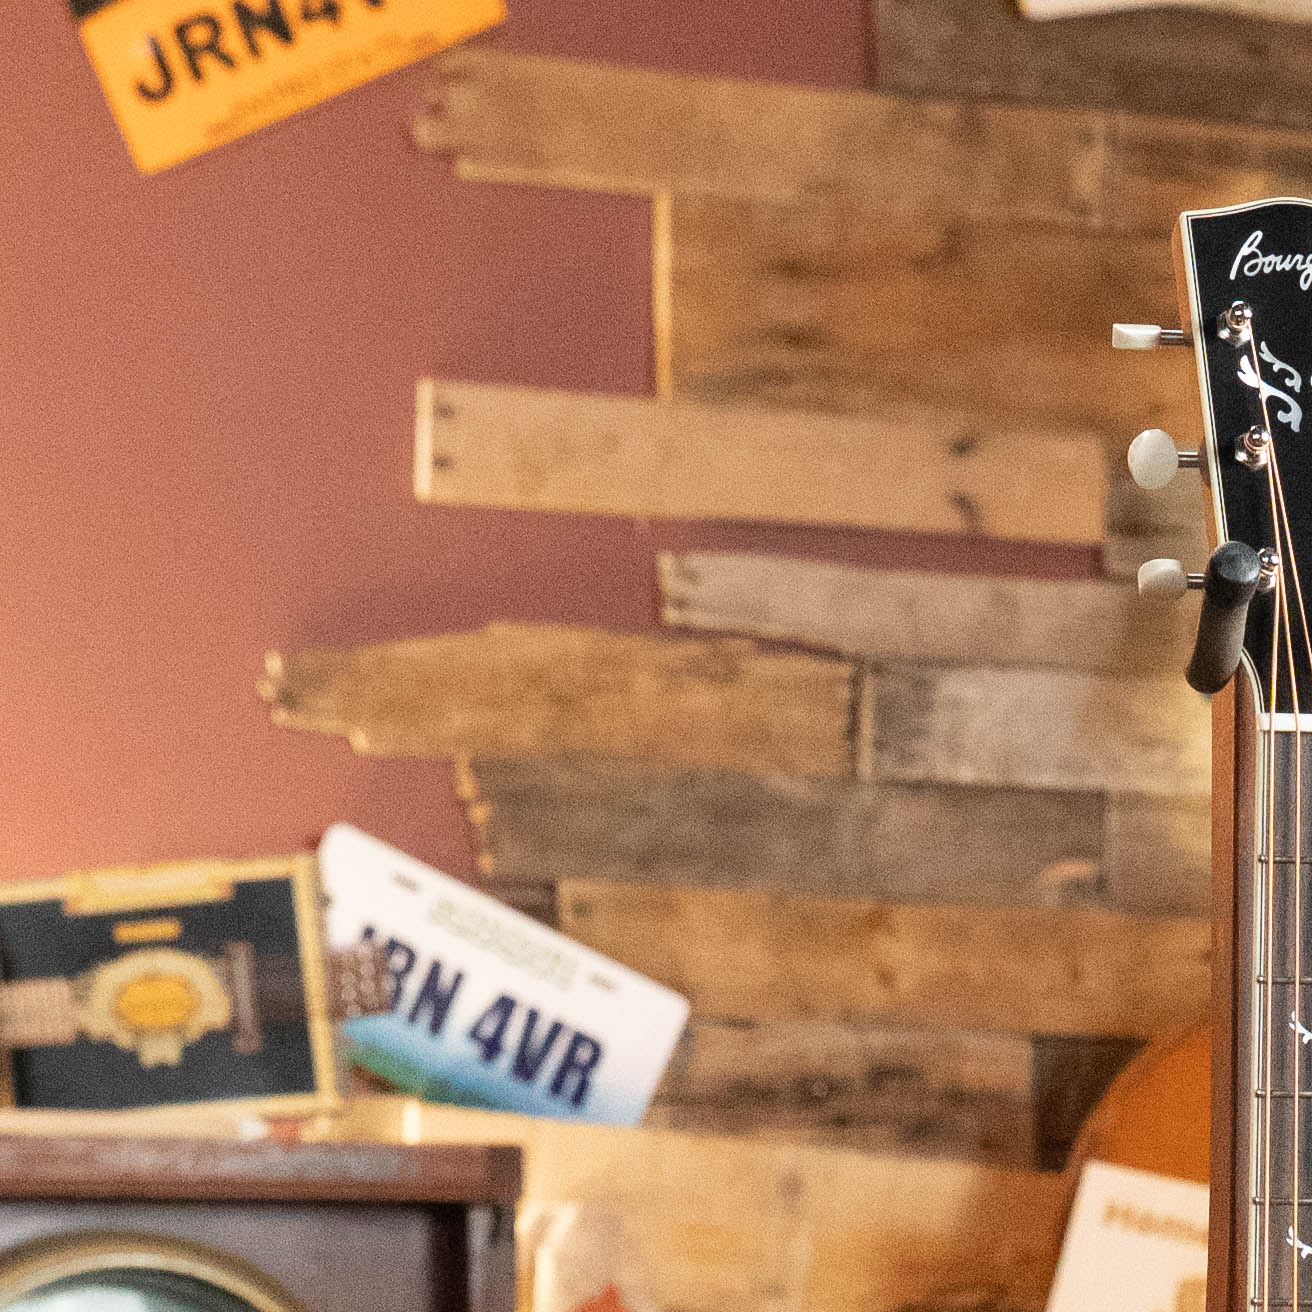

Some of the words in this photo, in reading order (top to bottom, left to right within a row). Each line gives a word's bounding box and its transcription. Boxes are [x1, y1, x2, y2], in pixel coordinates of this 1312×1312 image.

[135, 0, 388, 101] JRN4
[362, 926, 463, 1036] RN
[469, 995, 602, 1108] 4VR
